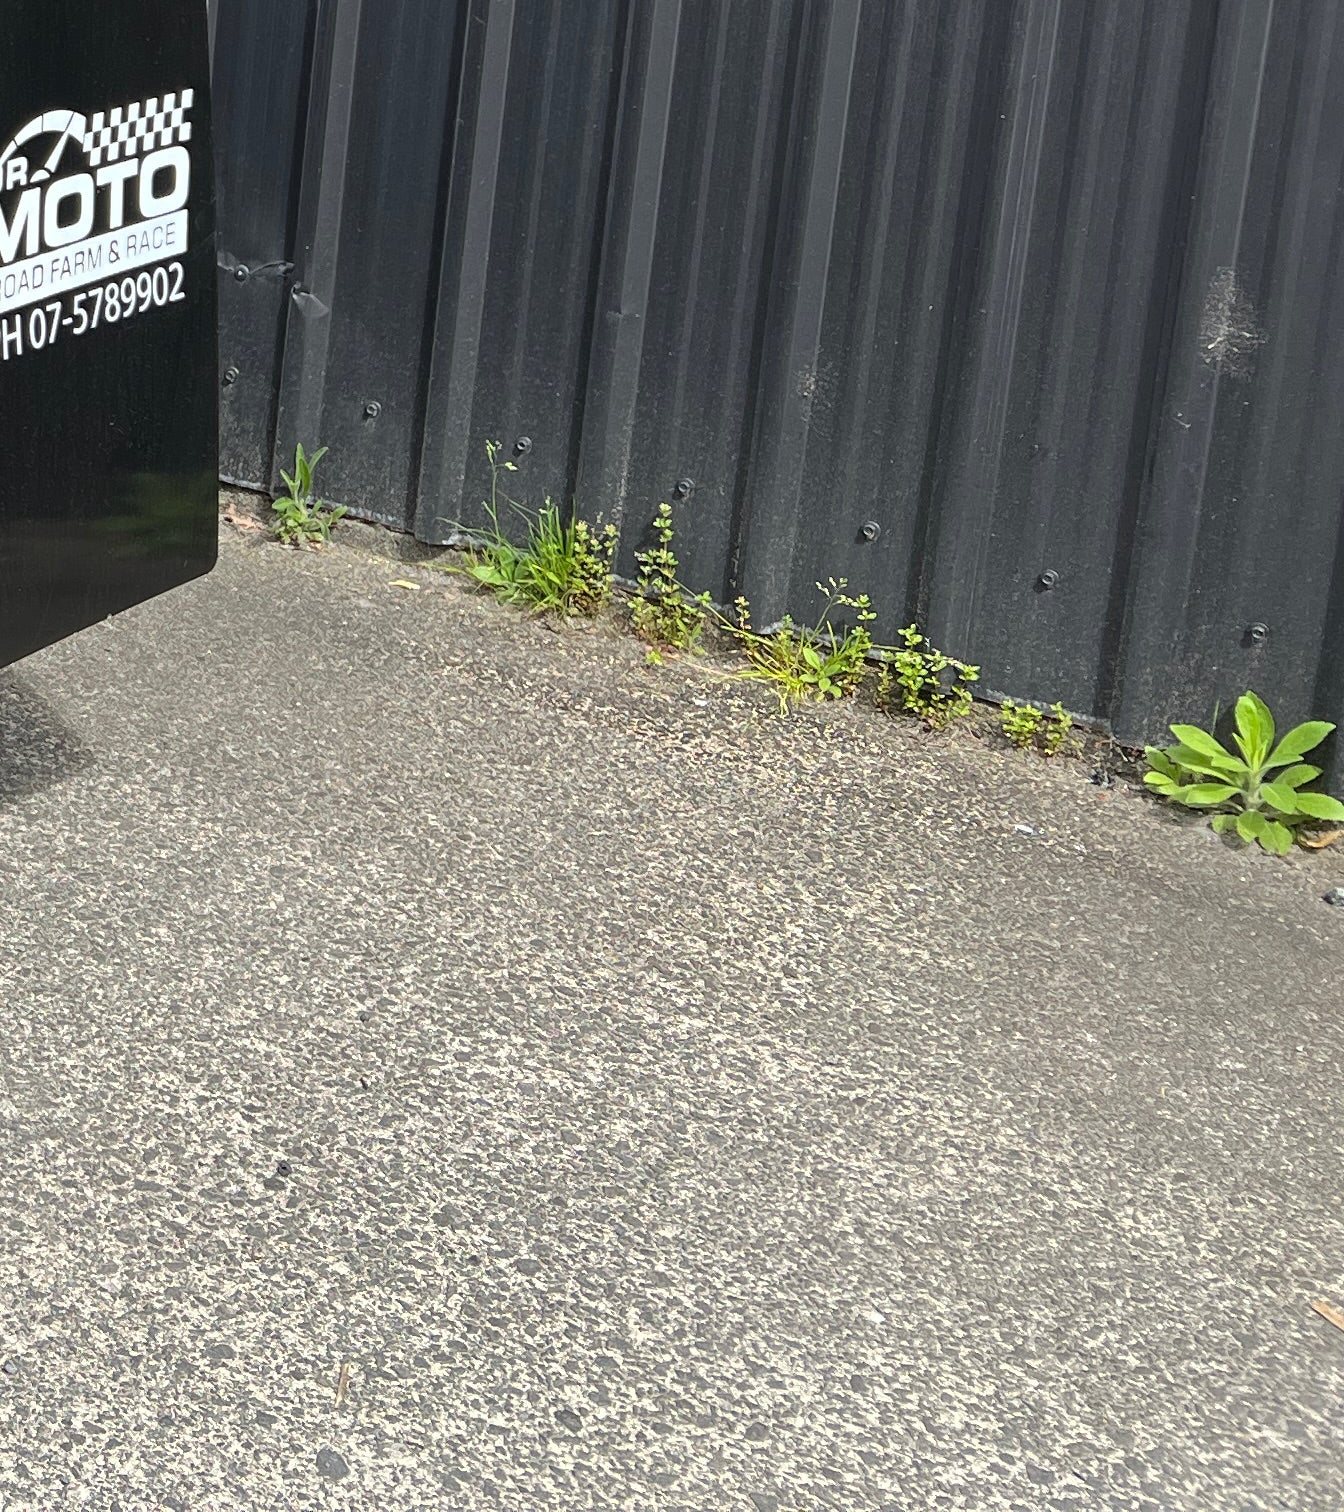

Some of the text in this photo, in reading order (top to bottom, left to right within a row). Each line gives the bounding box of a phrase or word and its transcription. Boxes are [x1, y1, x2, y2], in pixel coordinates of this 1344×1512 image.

[50, 245, 103, 284] FARM
[108, 239, 121, 262] &
[126, 221, 176, 259] RACE
[29, 261, 186, 350] 07-5789902
